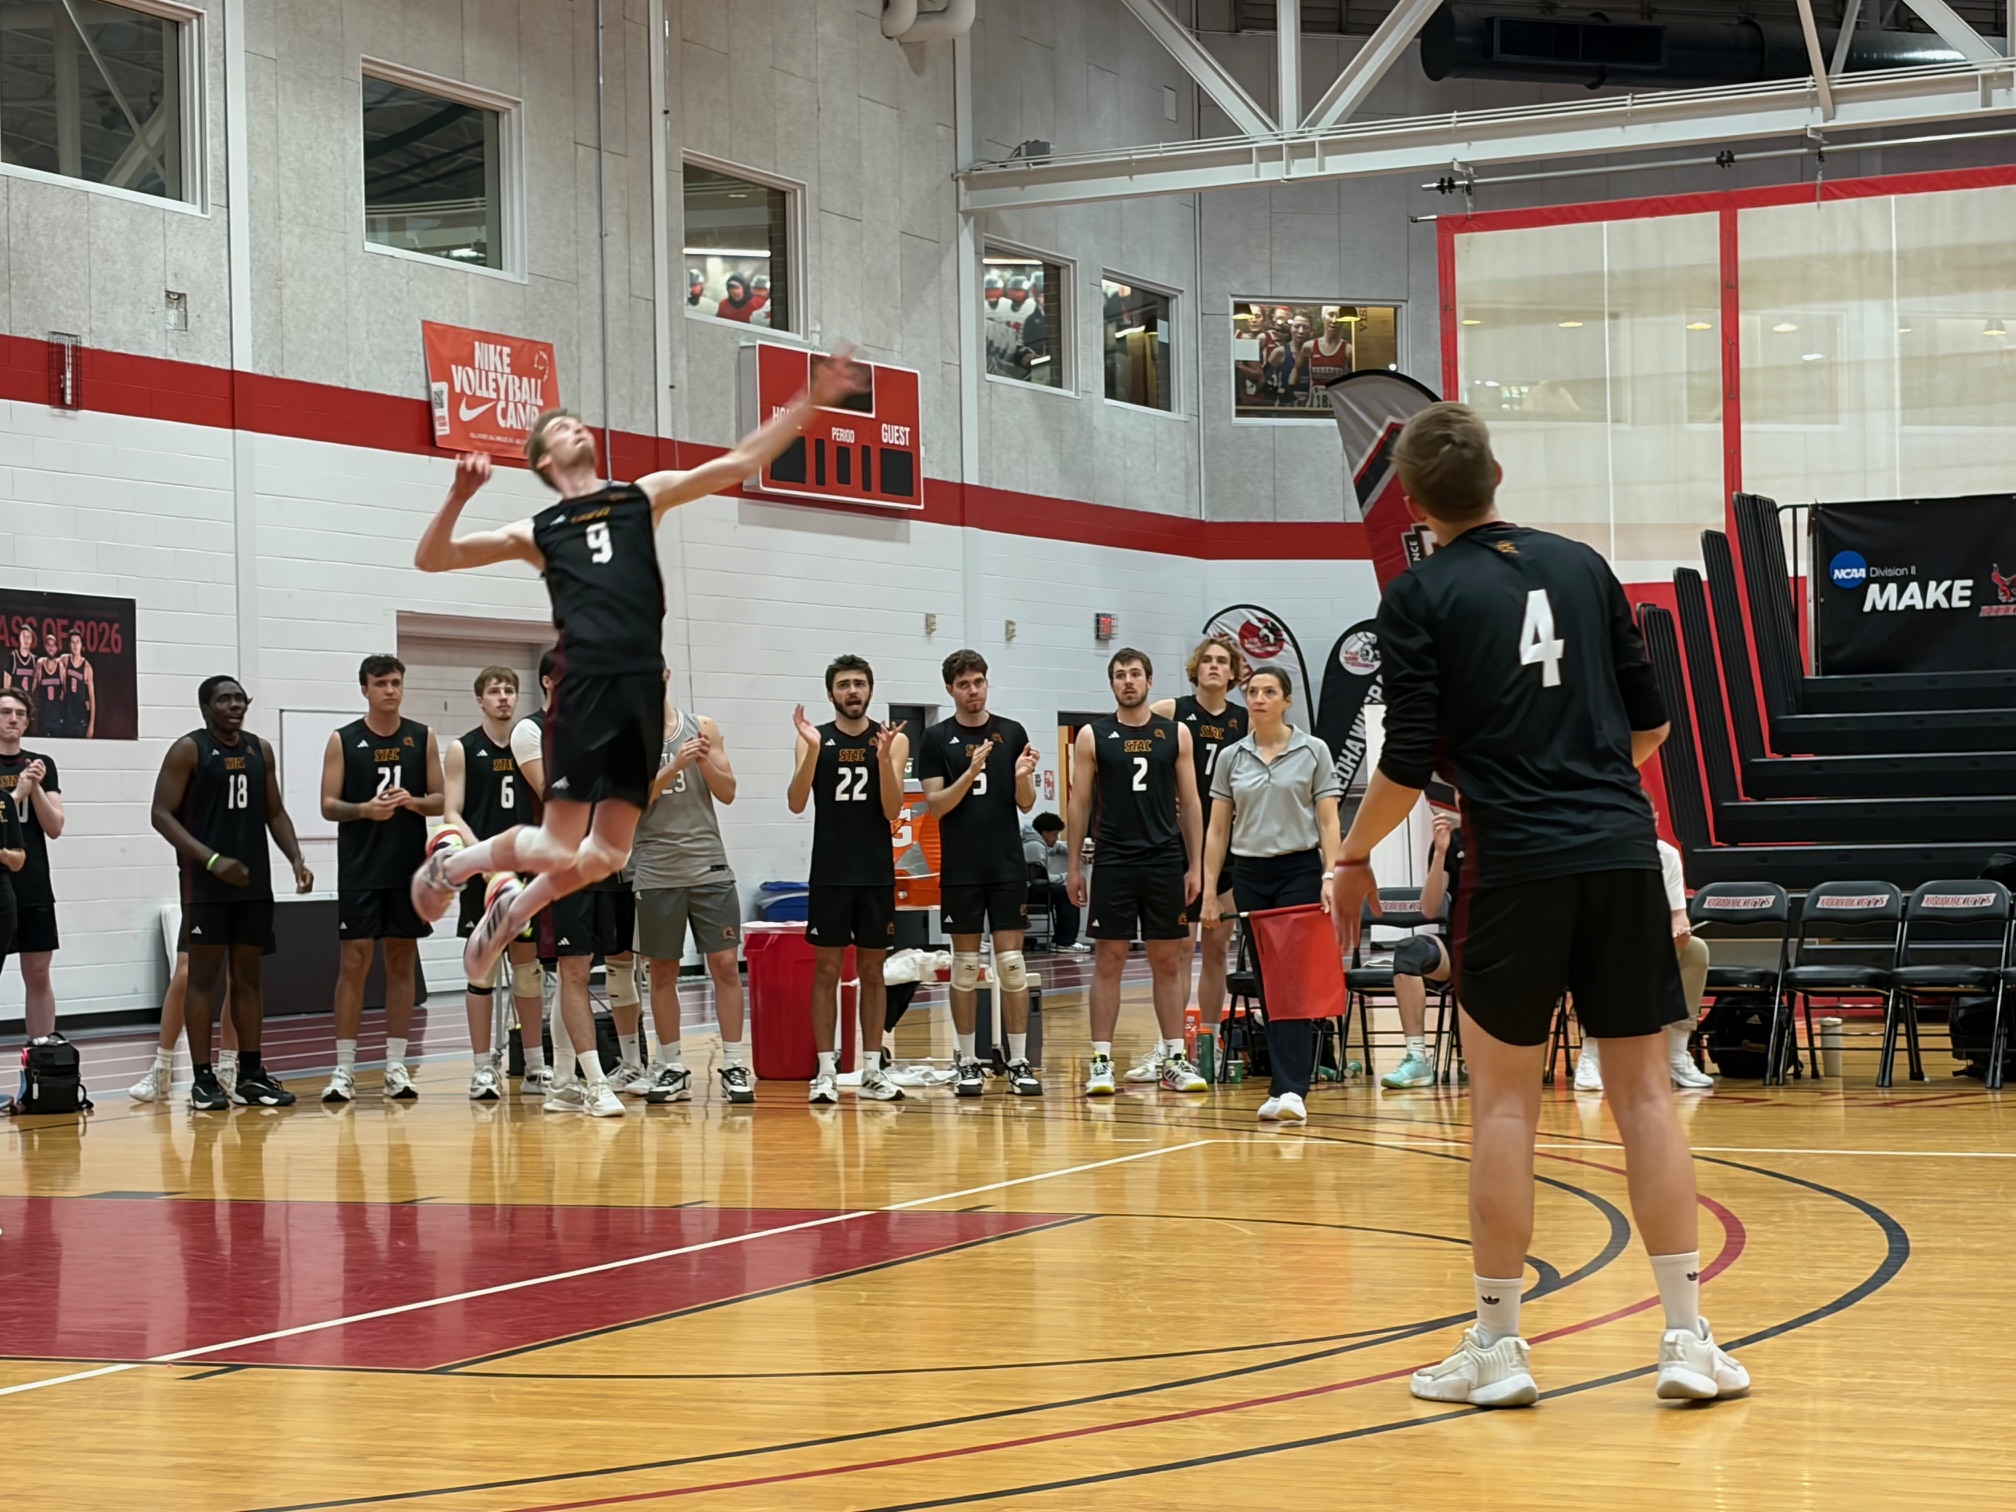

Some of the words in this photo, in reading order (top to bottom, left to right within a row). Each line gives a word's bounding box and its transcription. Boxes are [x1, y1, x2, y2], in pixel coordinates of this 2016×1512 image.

[474, 341, 511, 373] NIKE
[451, 364, 543, 406] VOLLEYBALL
[831, 427, 855, 443] PERIOD
[881, 423, 911, 446] GUEST
[586, 521, 613, 564] 9
[1833, 568, 1867, 579] NCAA
[1869, 566, 1908, 578] Division
[1863, 579, 1974, 612] MAKE
[73, 620, 122, 653] 2026
[1519, 588, 1565, 687] 4
[838, 748, 866, 762] STAC
[1124, 740, 1152, 752] STAC
[1205, 743, 1218, 775] 7
[835, 767, 868, 801] 22
[1132, 757, 1148, 791] 2
[228, 774, 248, 809] 18
[501, 776, 514, 809] 6
